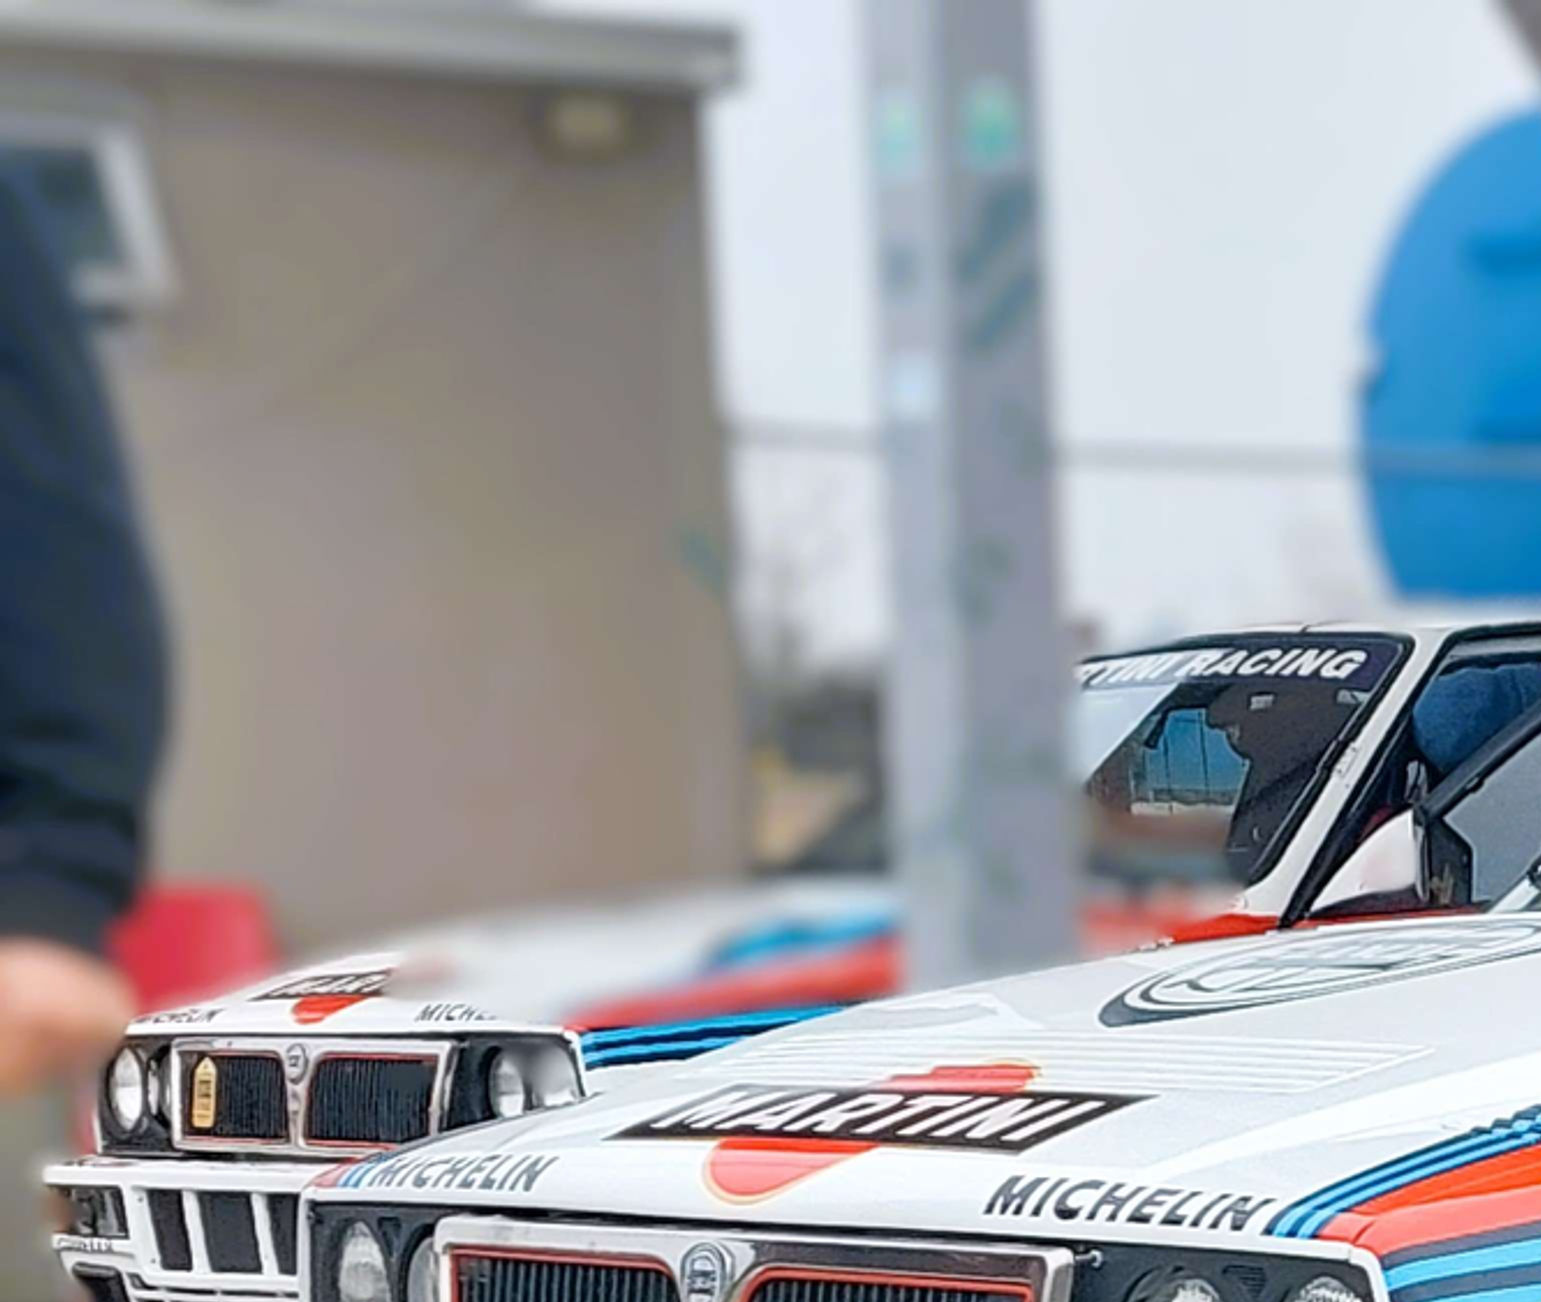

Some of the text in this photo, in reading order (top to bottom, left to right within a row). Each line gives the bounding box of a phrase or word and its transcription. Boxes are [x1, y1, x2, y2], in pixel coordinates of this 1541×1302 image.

[1176, 649, 1367, 679] RACING
[650, 1091, 1108, 1143] MARTINI
[367, 1155, 560, 1192] MICHELIN
[981, 1173, 1276, 1233] MICHELIN
